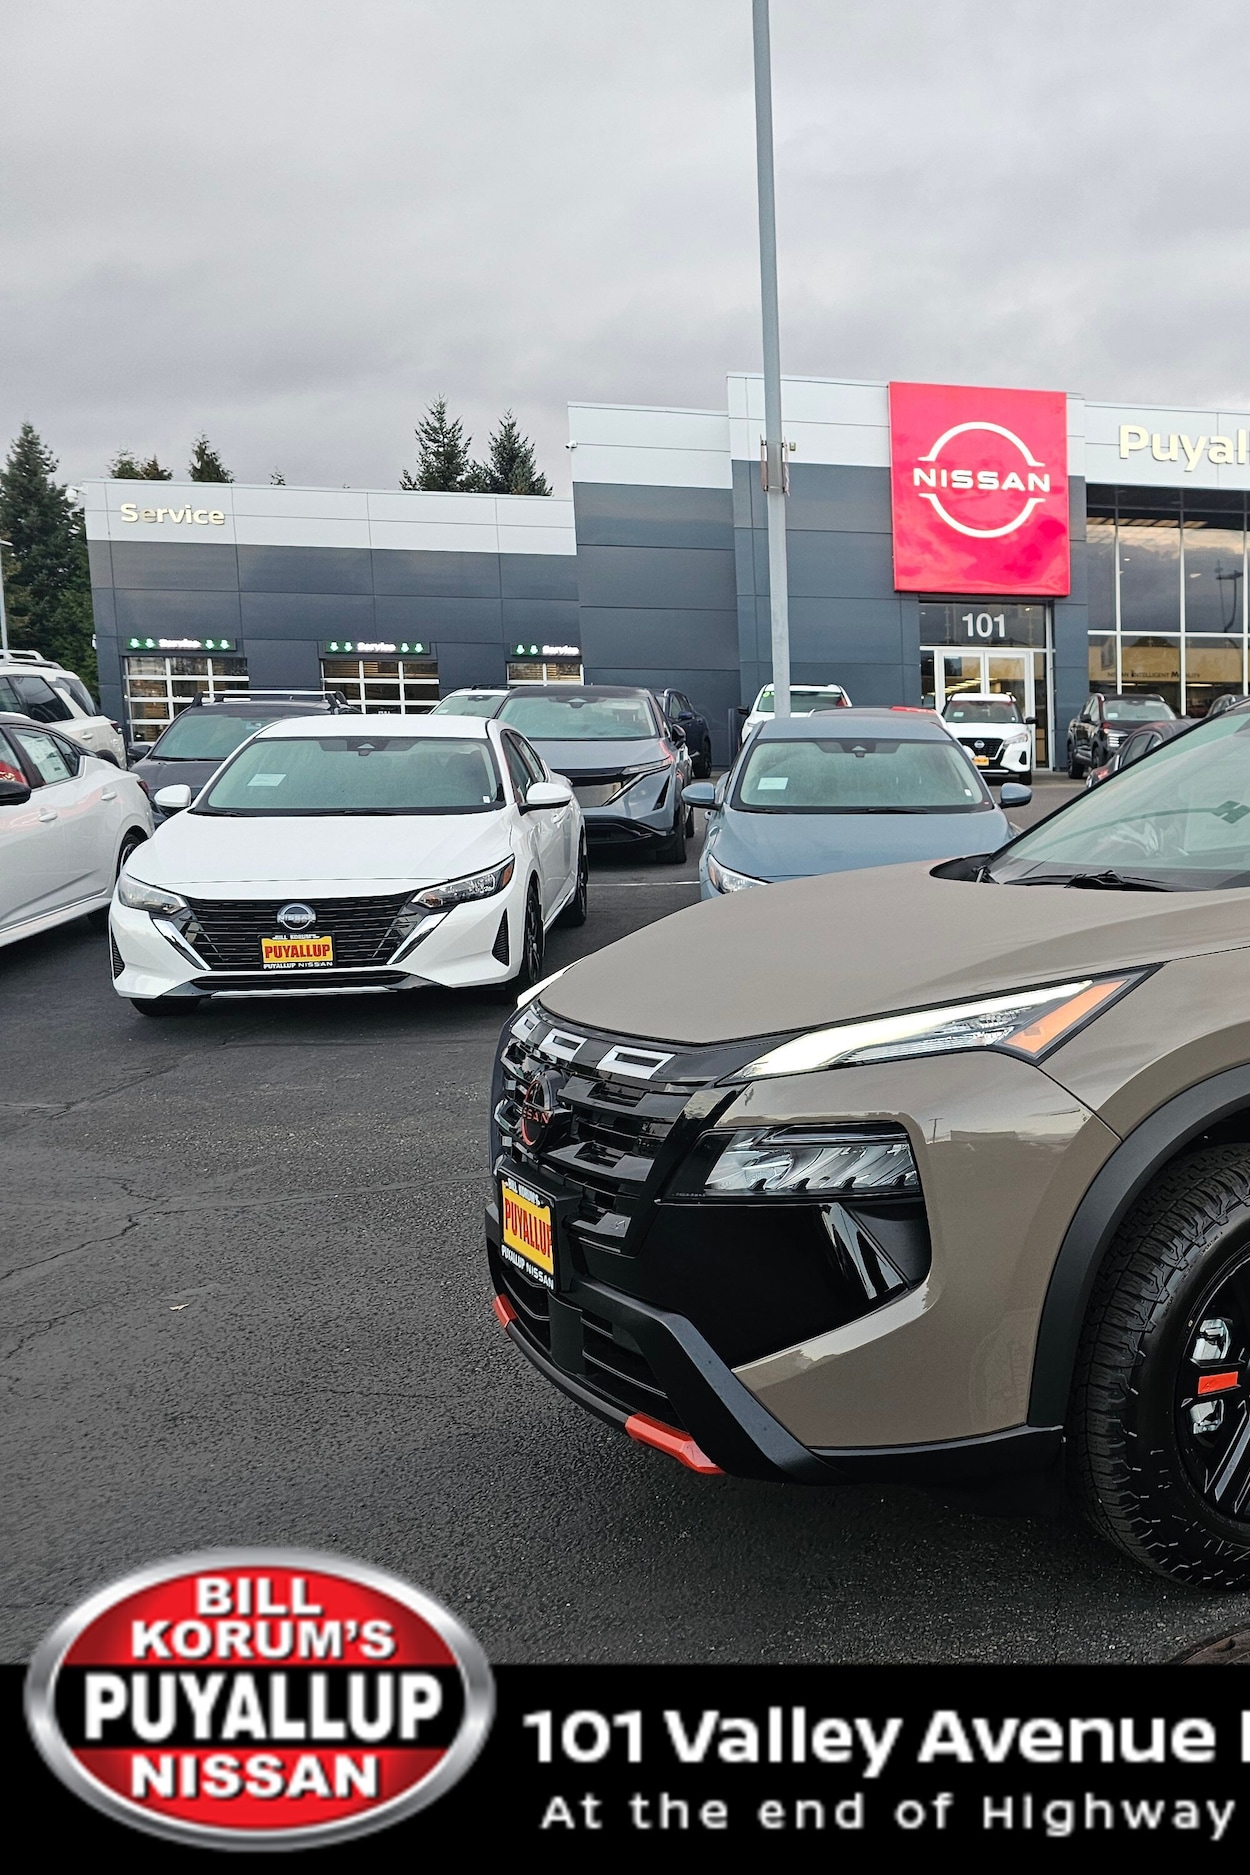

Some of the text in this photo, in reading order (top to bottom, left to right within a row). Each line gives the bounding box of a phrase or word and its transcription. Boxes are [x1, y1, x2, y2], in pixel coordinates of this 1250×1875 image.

[913, 468, 1050, 492] NISSAN
[120, 503, 225, 525] Service
[962, 613, 1005, 638] 101
[357, 641, 397, 652] Service
[264, 944, 331, 959] PUYALLUP
[525, 1260, 554, 1290] NISSAN
